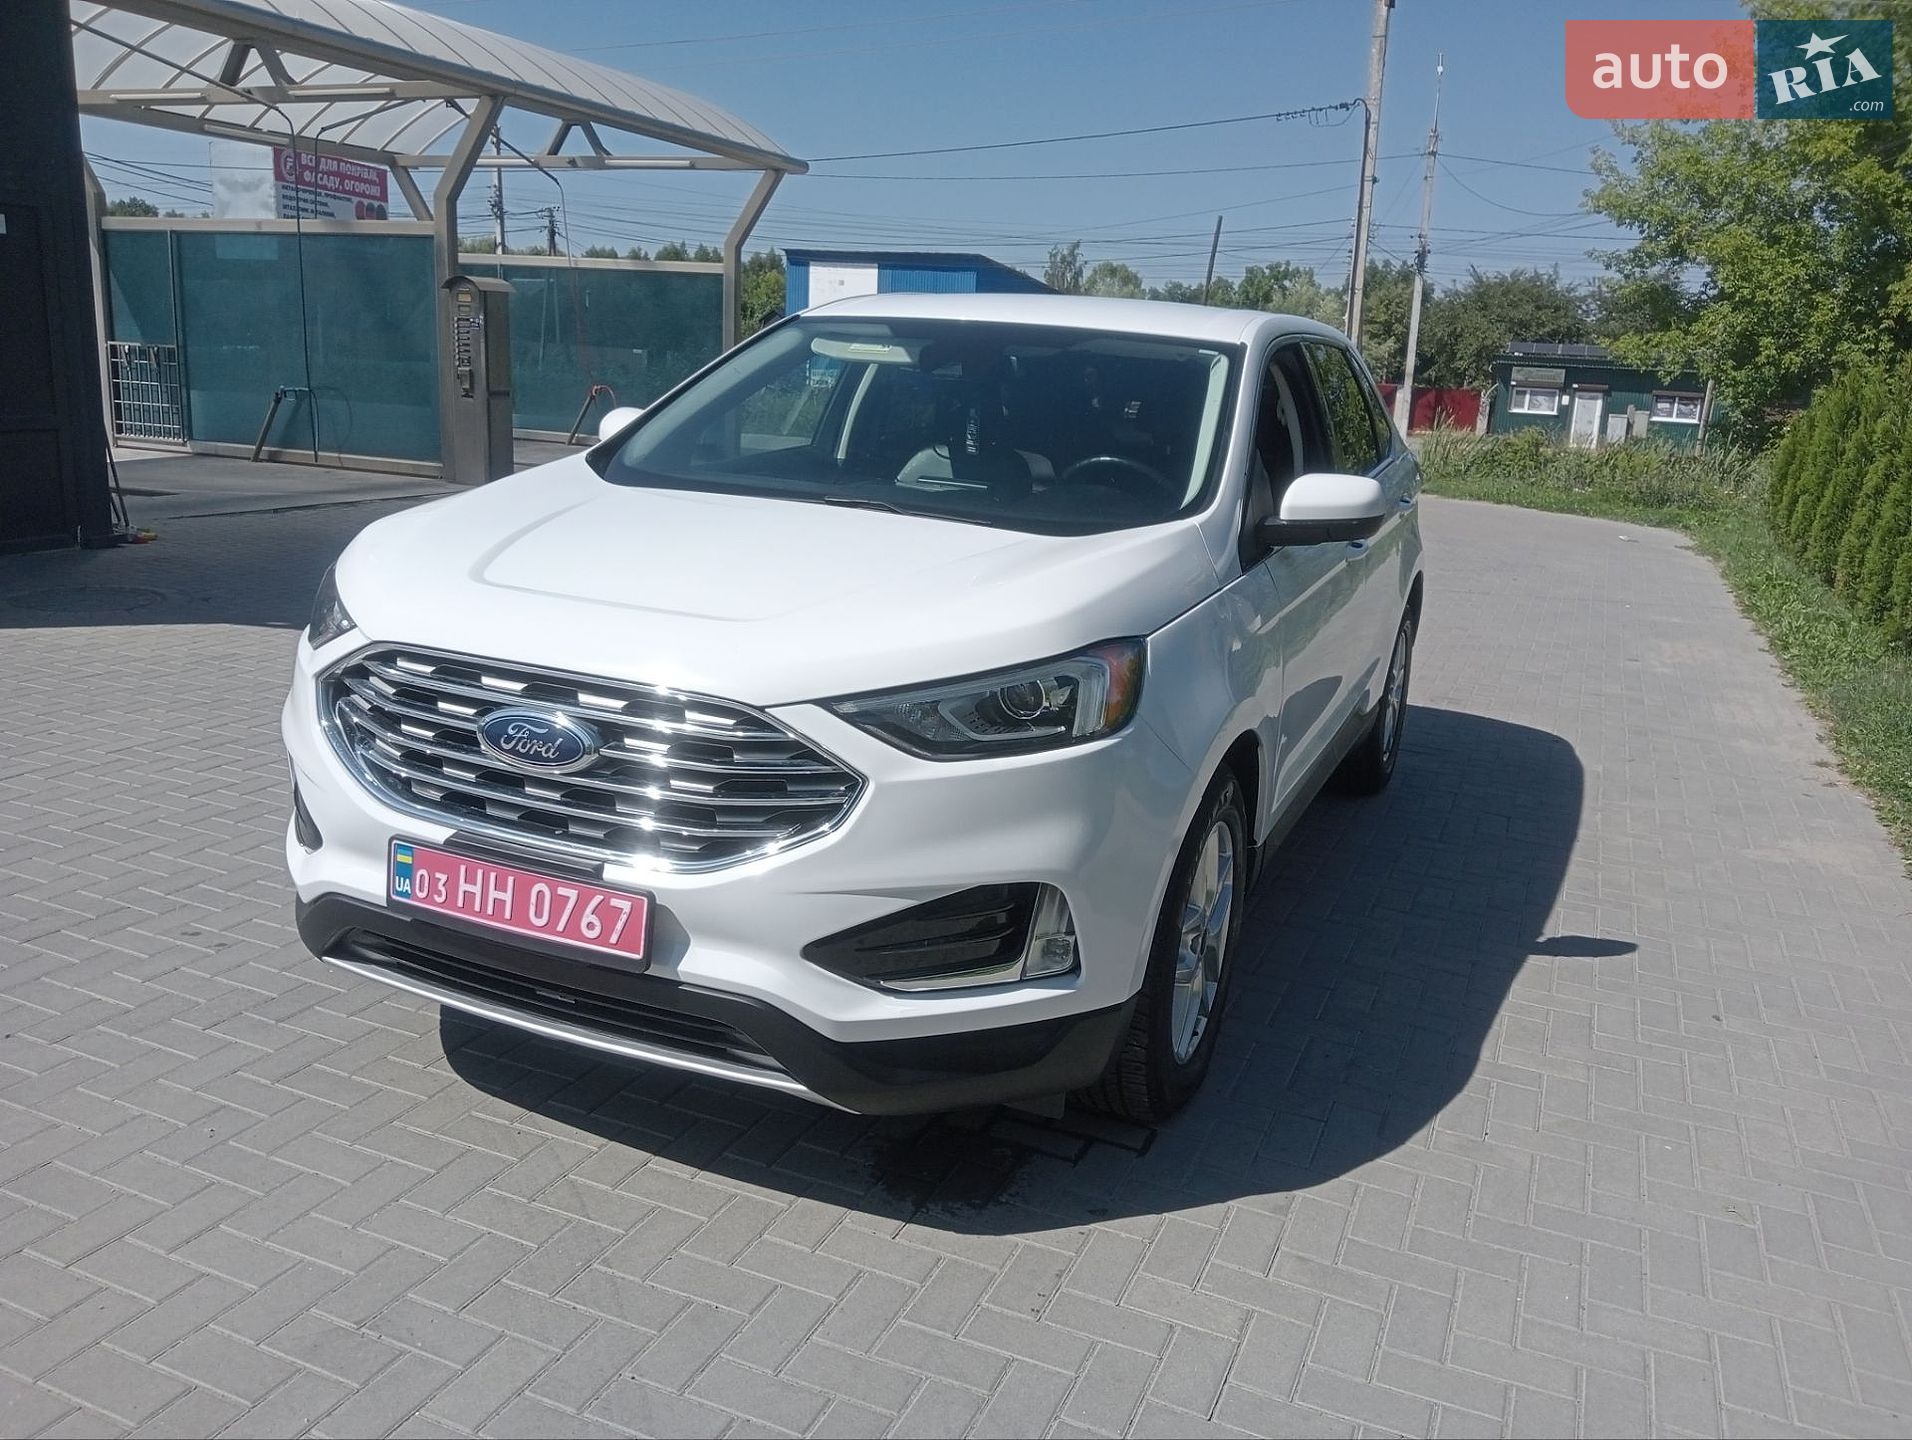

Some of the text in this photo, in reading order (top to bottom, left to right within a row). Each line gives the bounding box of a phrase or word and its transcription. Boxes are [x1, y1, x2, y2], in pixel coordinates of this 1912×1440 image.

[319, 157, 338, 172] ДЛЯ
[500, 722, 562, 759] Ford
[395, 876, 412, 895] UA
[415, 864, 632, 944] 03 HH 0767
